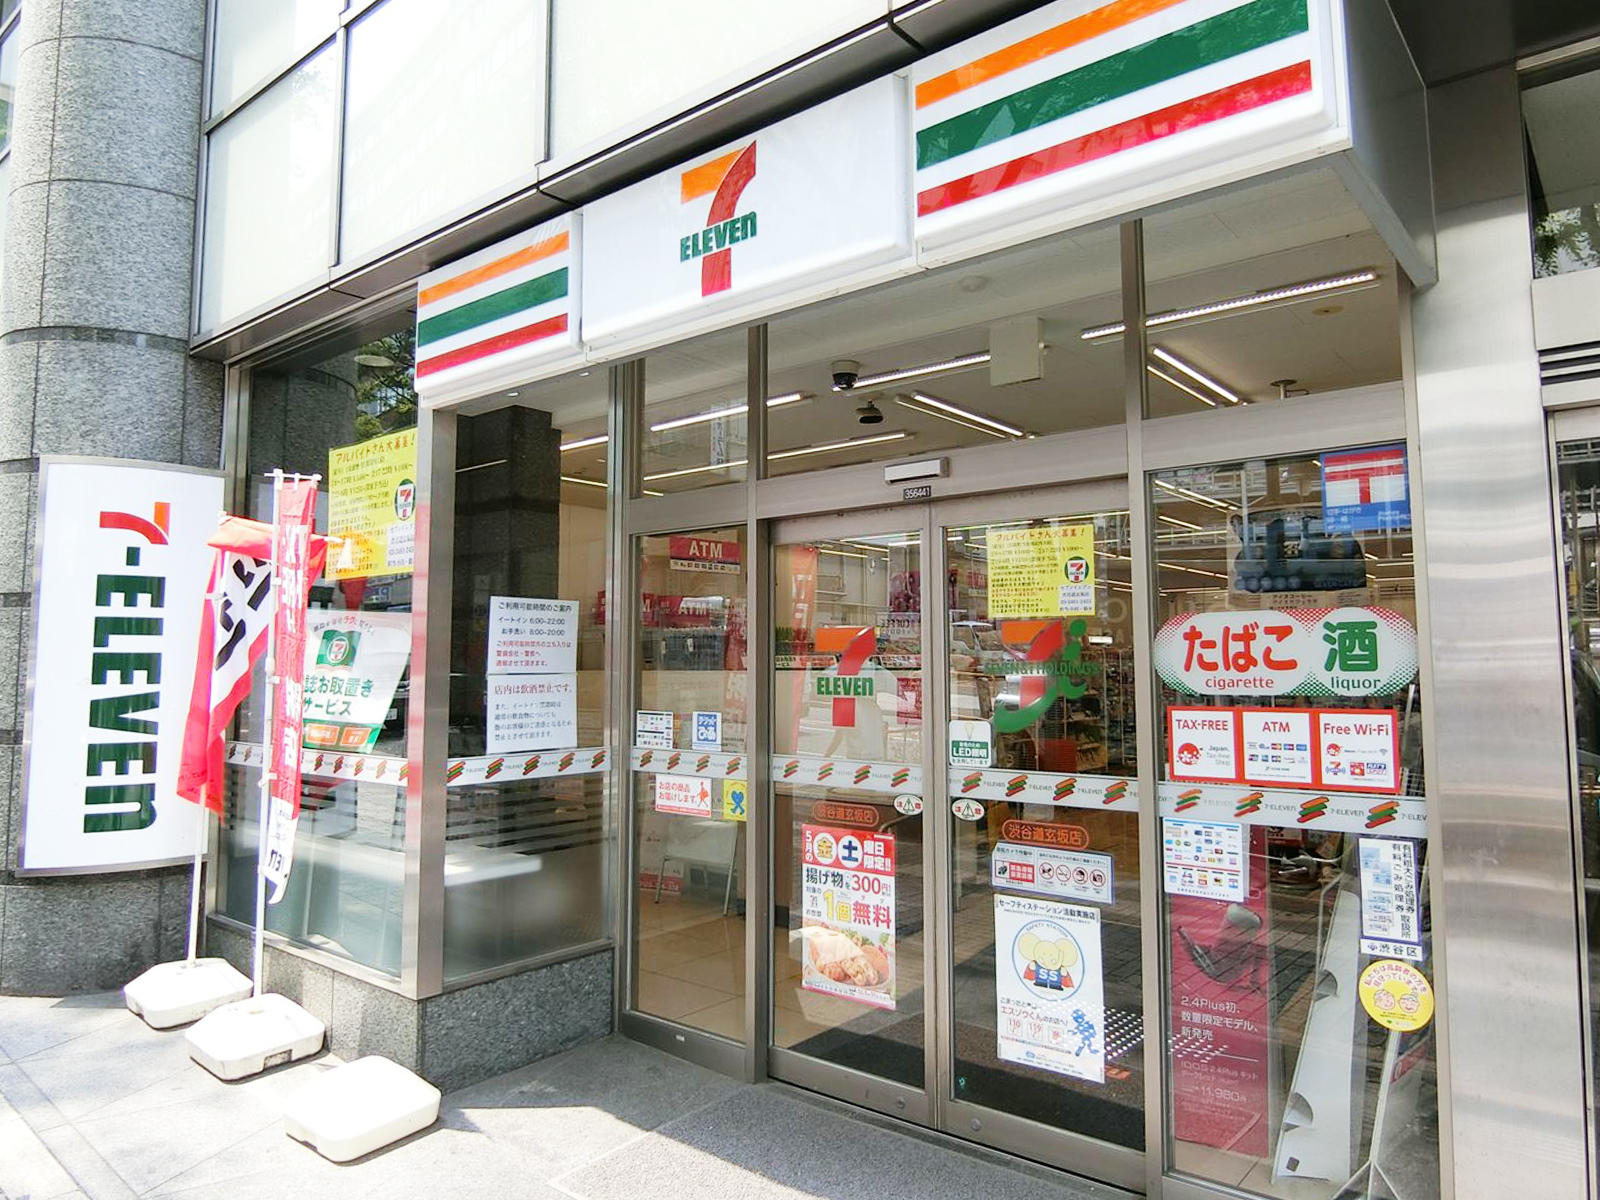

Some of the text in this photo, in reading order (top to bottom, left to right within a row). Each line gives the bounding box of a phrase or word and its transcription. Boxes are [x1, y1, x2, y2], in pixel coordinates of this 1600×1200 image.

[689, 540, 723, 559] ATM
[1183, 621, 1298, 673] たばこ
[1322, 620, 1379, 673] 酒
[494, 683, 572, 695] 店内は飲酒禁止です。
[1205, 676, 1275, 690] cigarette
[1330, 676, 1382, 691] liquor
[1175, 719, 1229, 731] TAX-FREE
[1262, 721, 1291, 733] ATM
[1323, 723, 1389, 736] Free Wi-Fi
[952, 747, 988, 758] LED照明
[1008, 823, 1083, 846] 渋谷道玄坂店
[817, 836, 834, 860] 金
[841, 840, 859, 863] 土
[805, 866, 844, 889] 揚げ物
[851, 874, 881, 894] 300
[853, 900, 891, 930] 無料
[1379, 943, 1418, 957] 渋谷区
[1037, 968, 1058, 982] SS
[1180, 1026, 1214, 1041] 新発売
